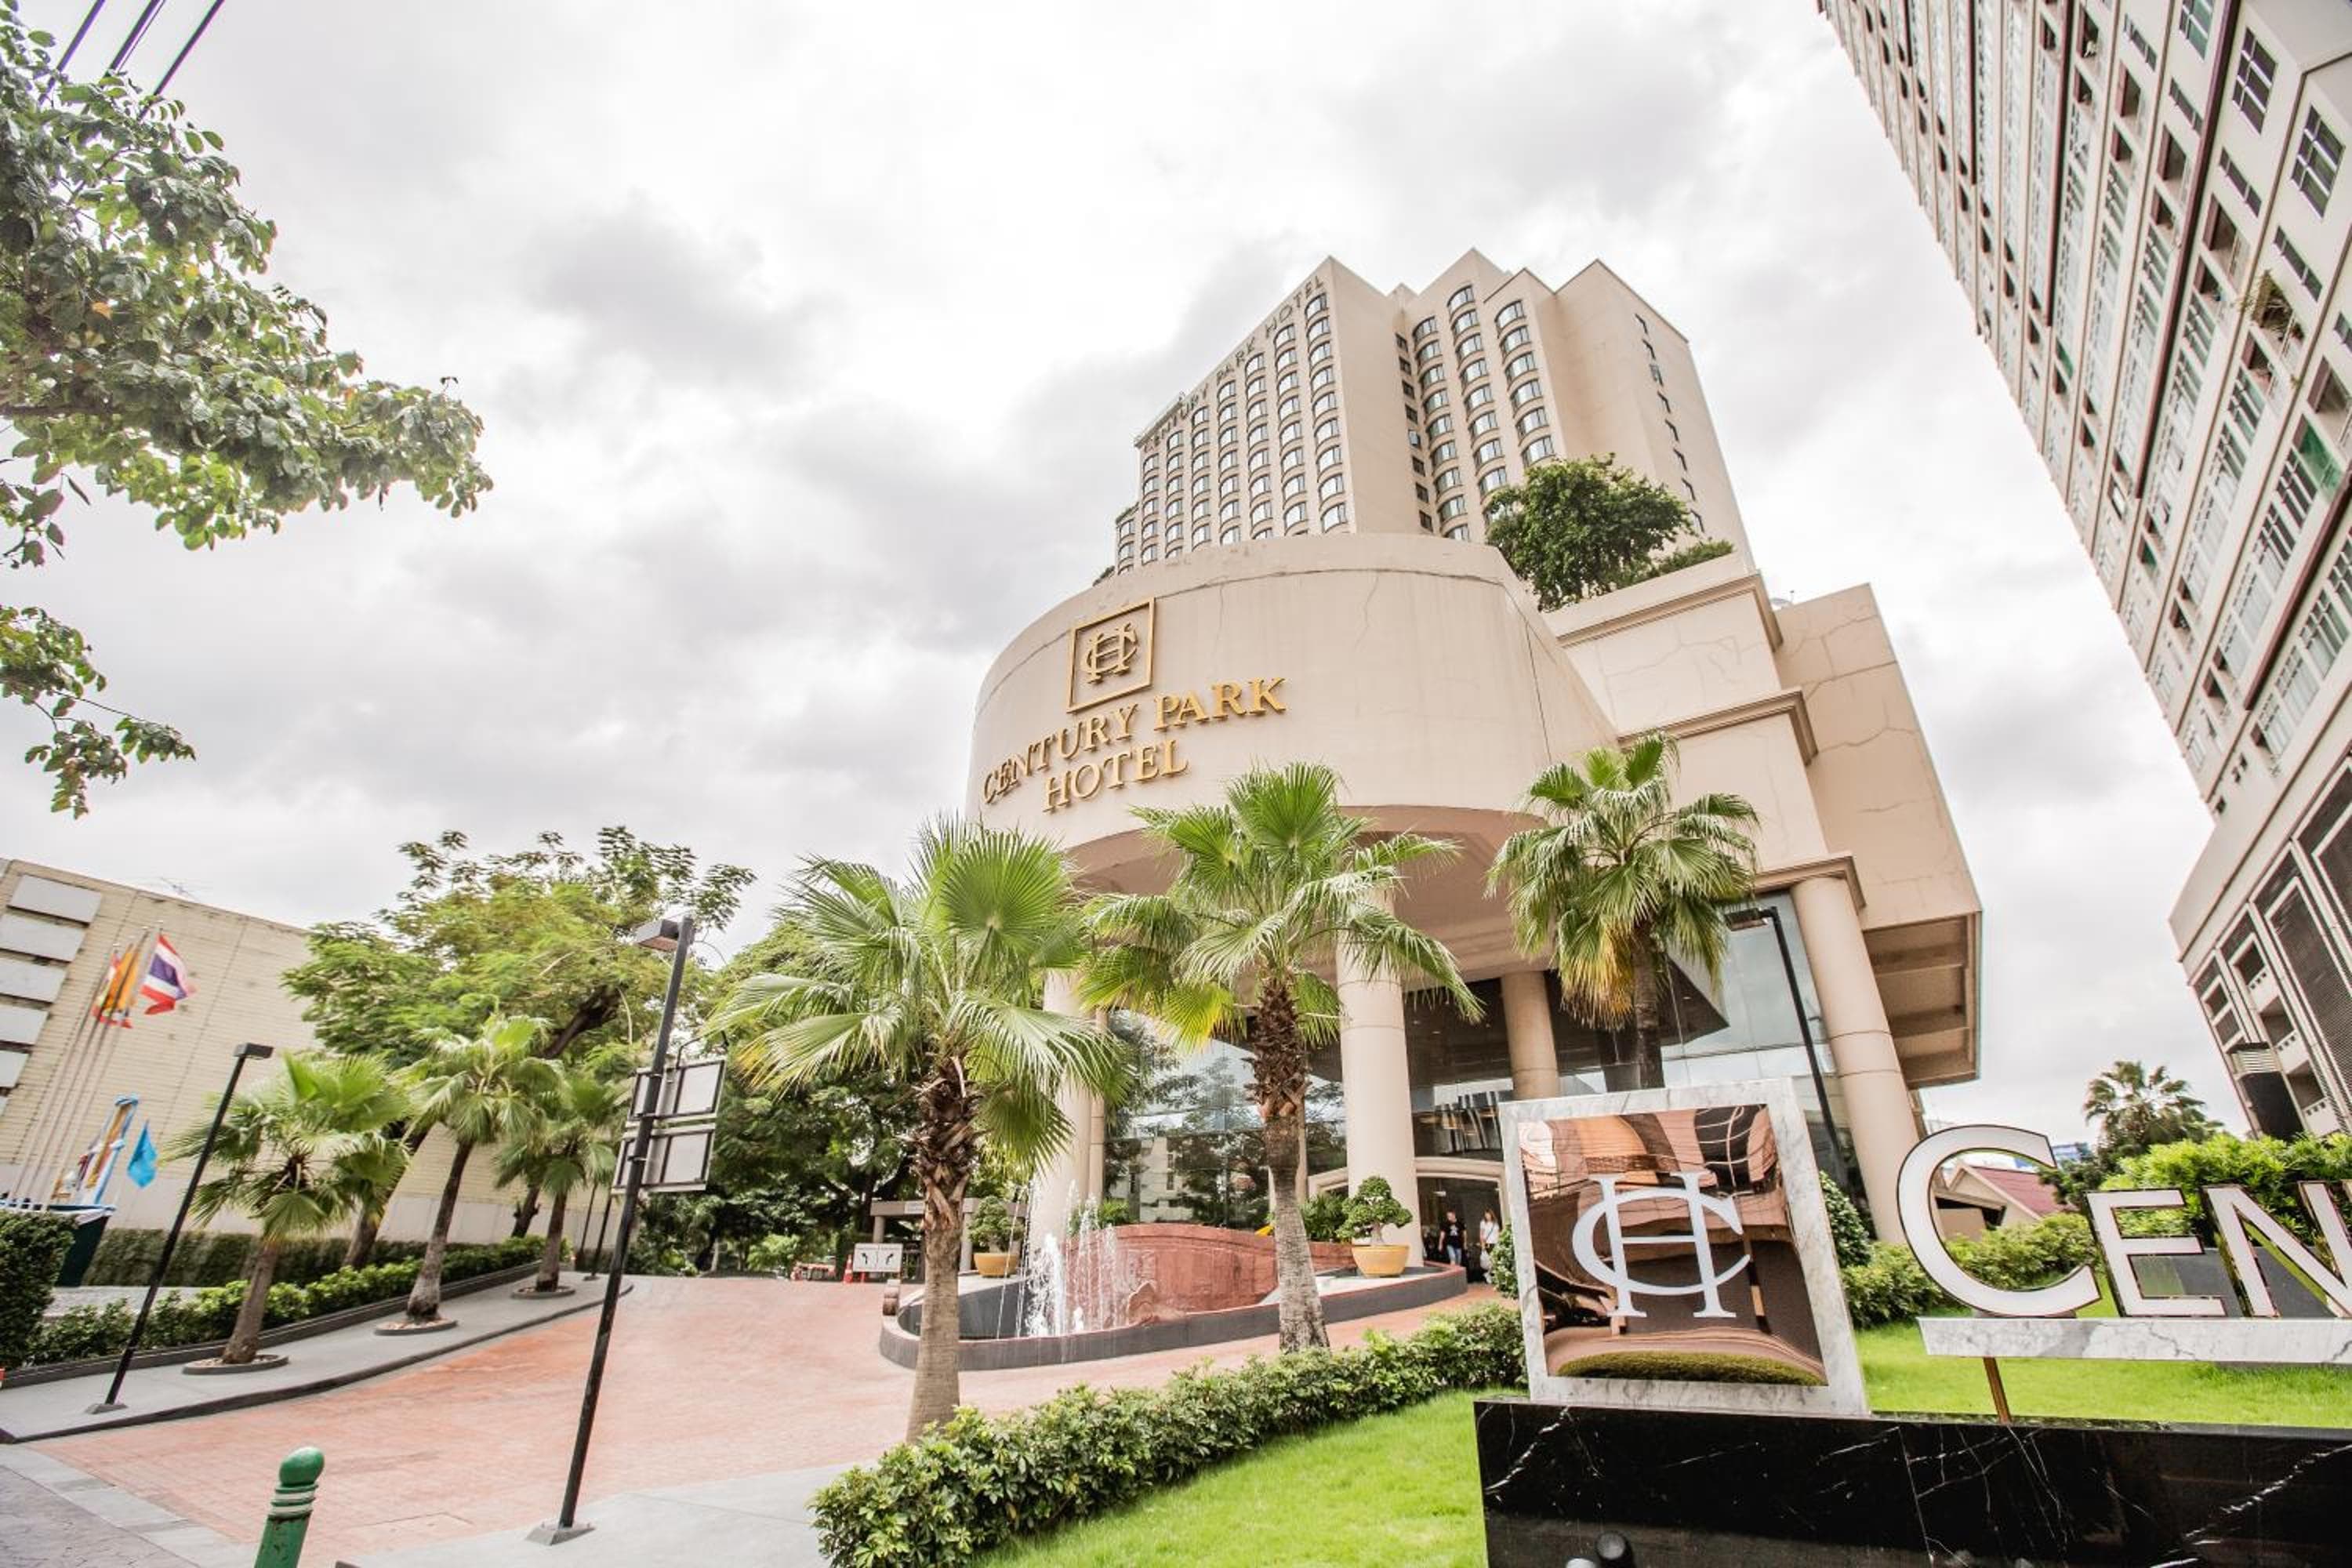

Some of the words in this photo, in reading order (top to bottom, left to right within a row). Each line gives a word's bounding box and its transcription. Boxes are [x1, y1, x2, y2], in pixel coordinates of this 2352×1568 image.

[1216, 336, 1255, 386] PARK
[1265, 274, 1323, 339] HOTEL
[983, 703, 1138, 804] CENTURY
[1152, 677, 1287, 732] PARK
[1041, 739, 1189, 813] HOTEL
[1896, 1123, 2352, 1318] CEN
